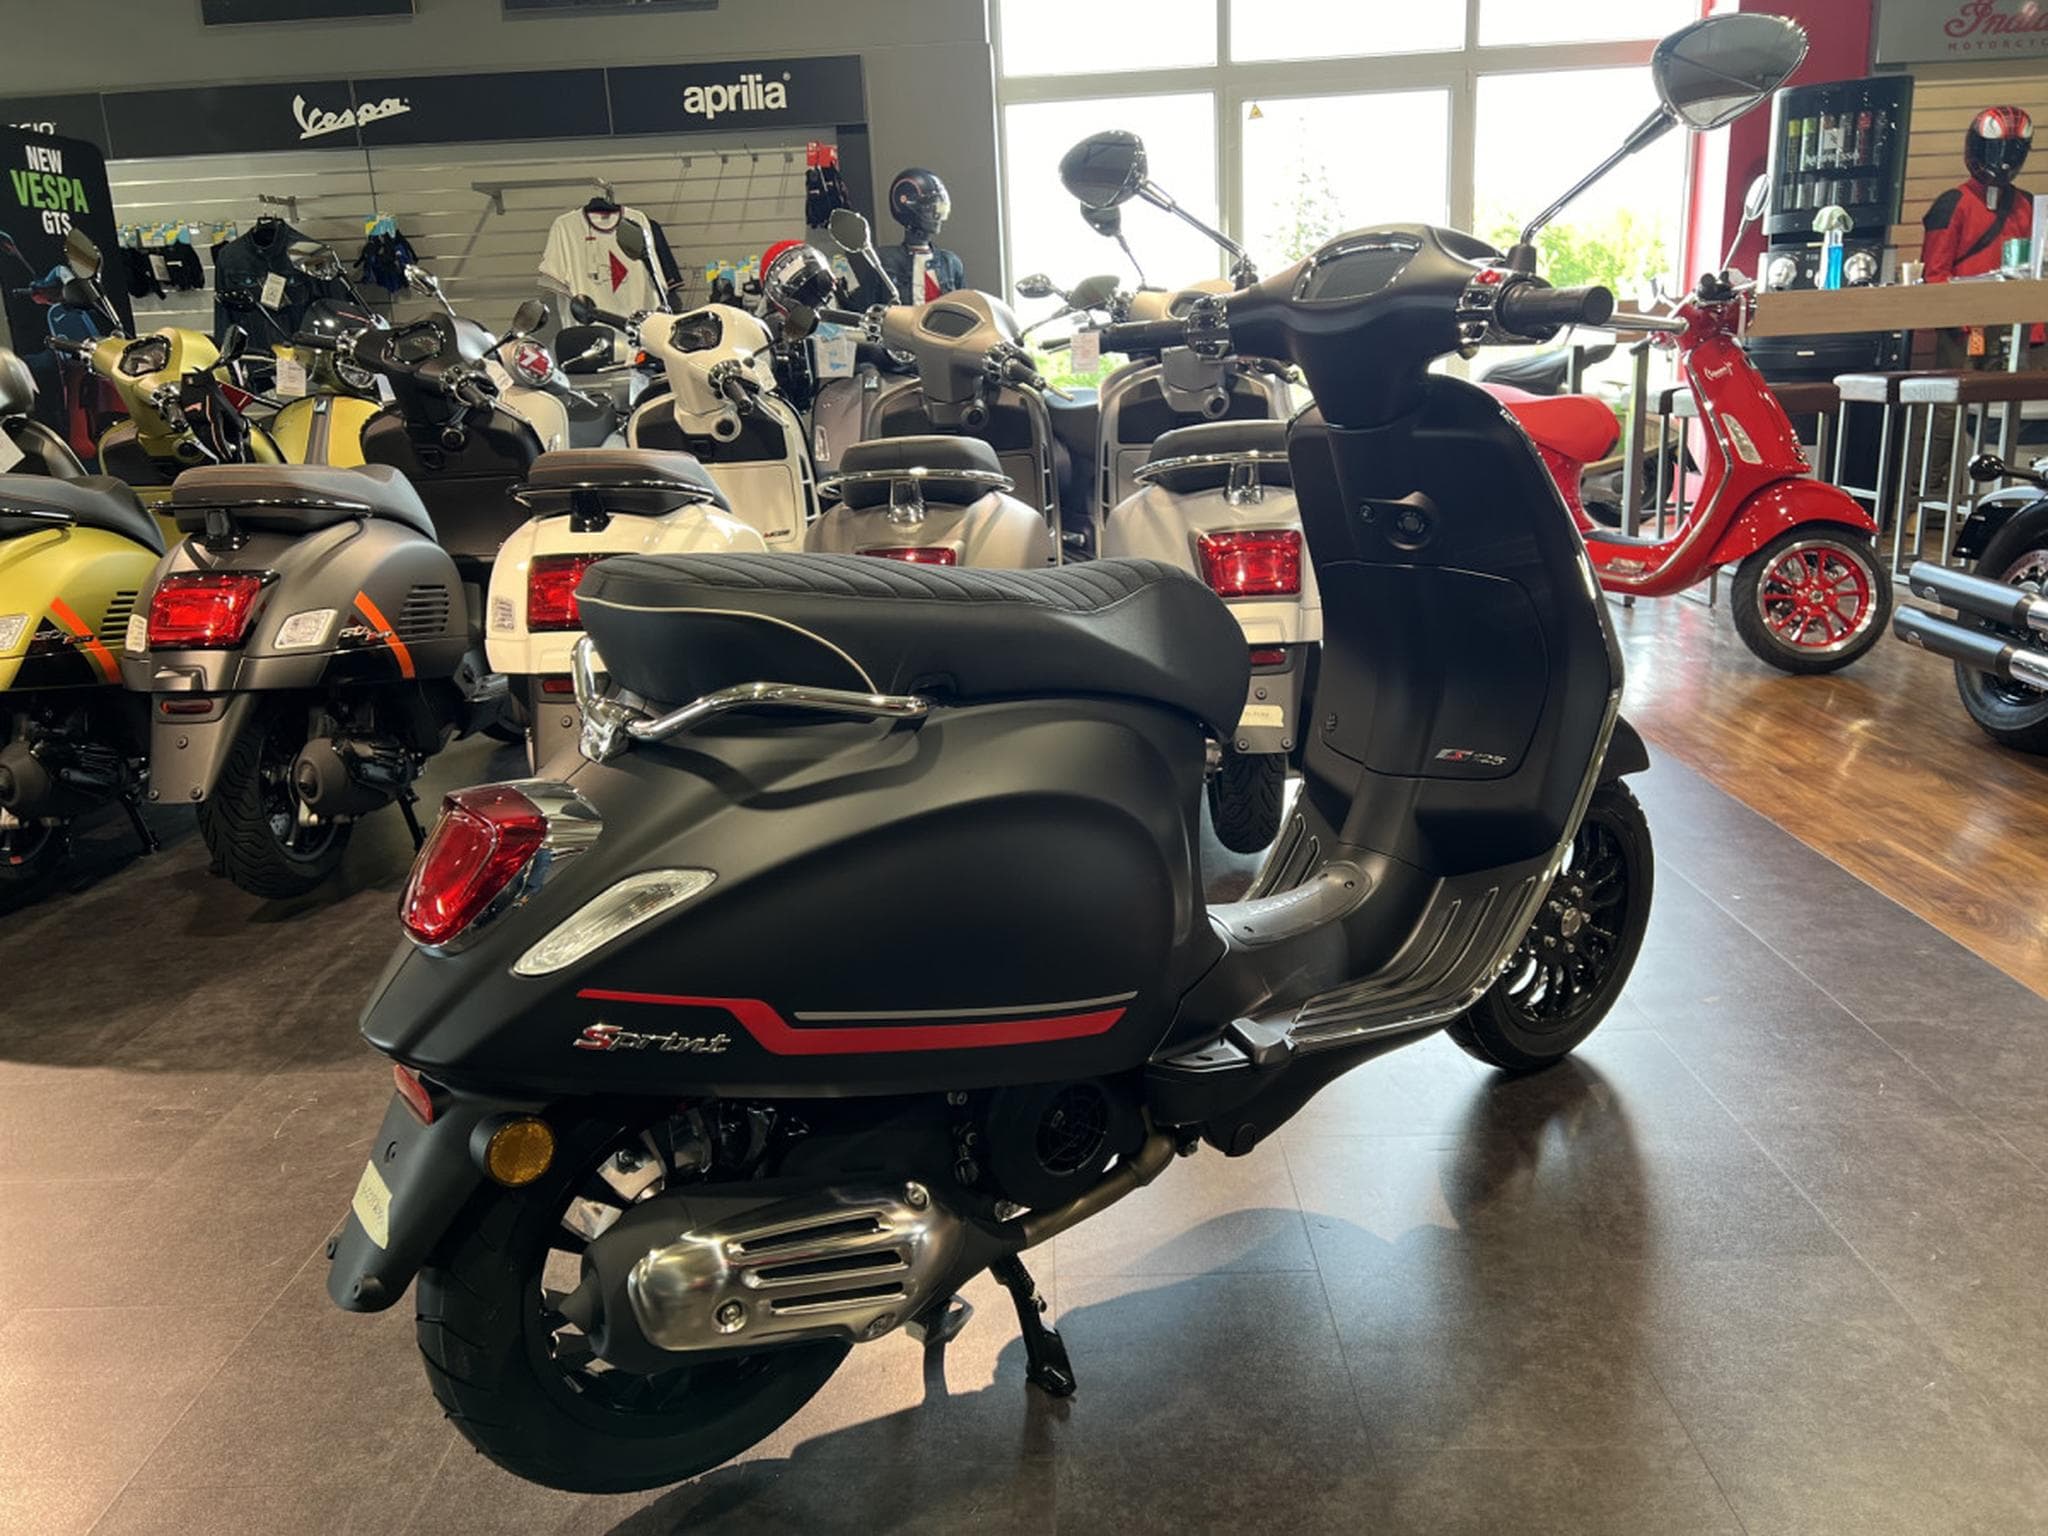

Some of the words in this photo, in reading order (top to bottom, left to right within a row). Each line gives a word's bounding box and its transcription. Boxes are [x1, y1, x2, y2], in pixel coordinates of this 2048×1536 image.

[683, 73, 787, 119] aprilia
[293, 94, 411, 140] Vespa
[25, 145, 63, 174] NEW
[9, 169, 90, 214] VESPA
[42, 210, 73, 237] GTS
[573, 1022, 731, 1053] Sprint
